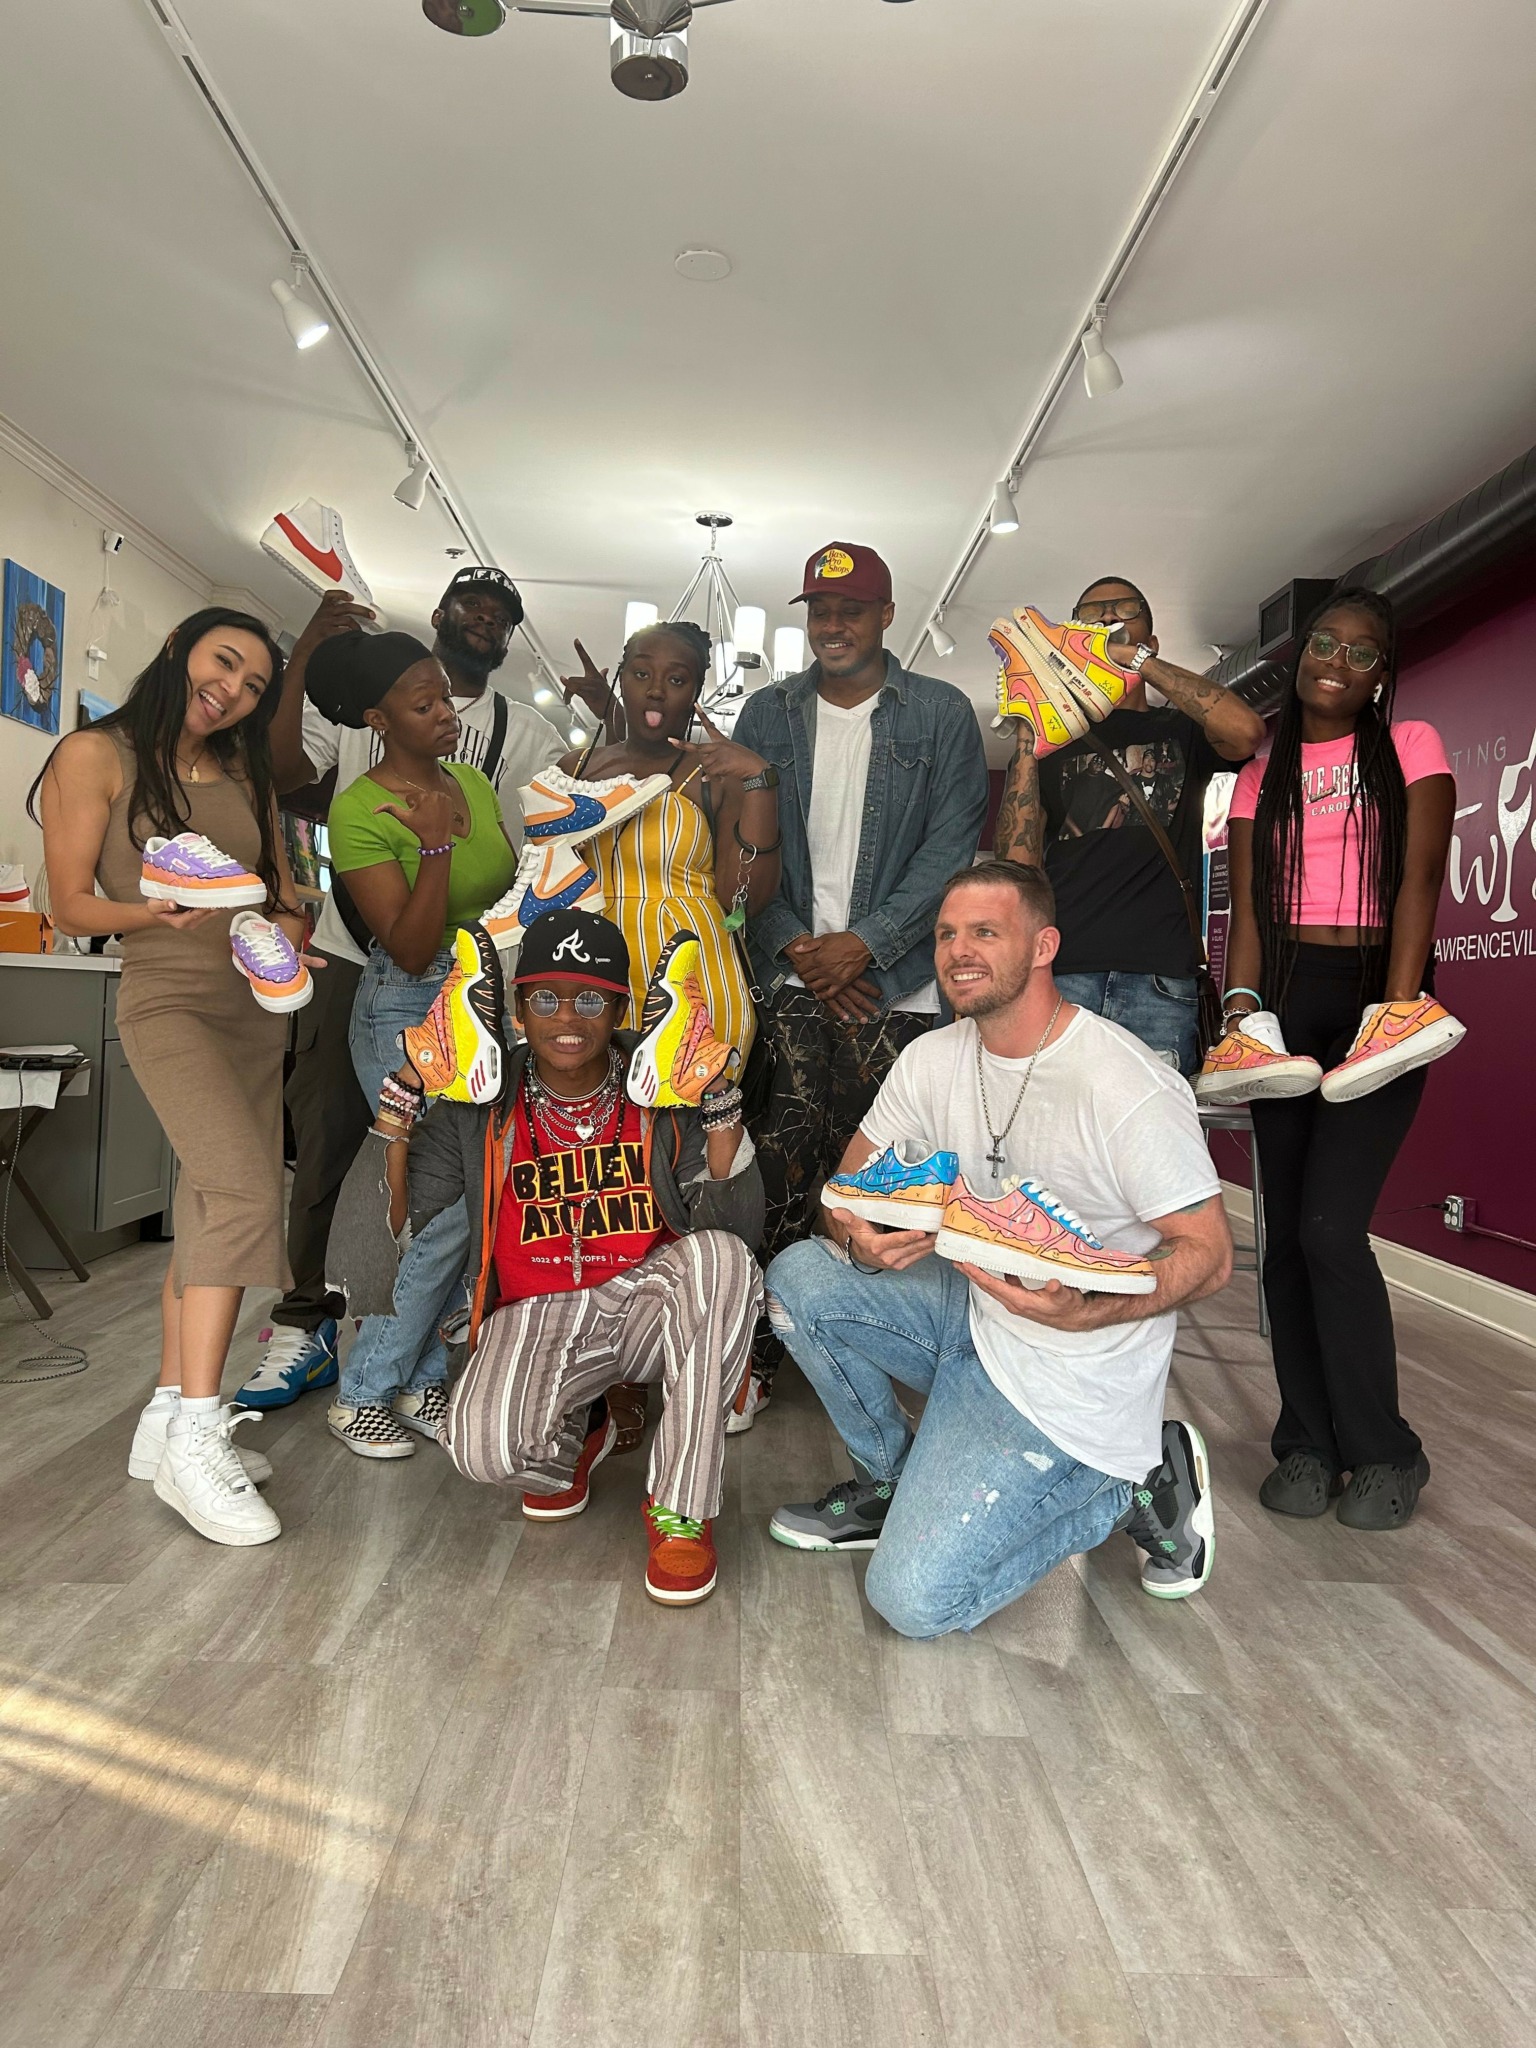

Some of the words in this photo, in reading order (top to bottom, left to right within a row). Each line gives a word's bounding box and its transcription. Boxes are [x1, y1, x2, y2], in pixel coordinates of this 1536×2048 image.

[828, 550, 847, 559] Bass
[828, 558, 842, 566] Pro
[828, 565, 850, 574] Shops
[1332, 762, 1362, 799] BEA
[511, 1142, 650, 1203] BELIEV
[531, 1256, 551, 1264] 2022
[564, 1255, 607, 1263] PLYOFFS
